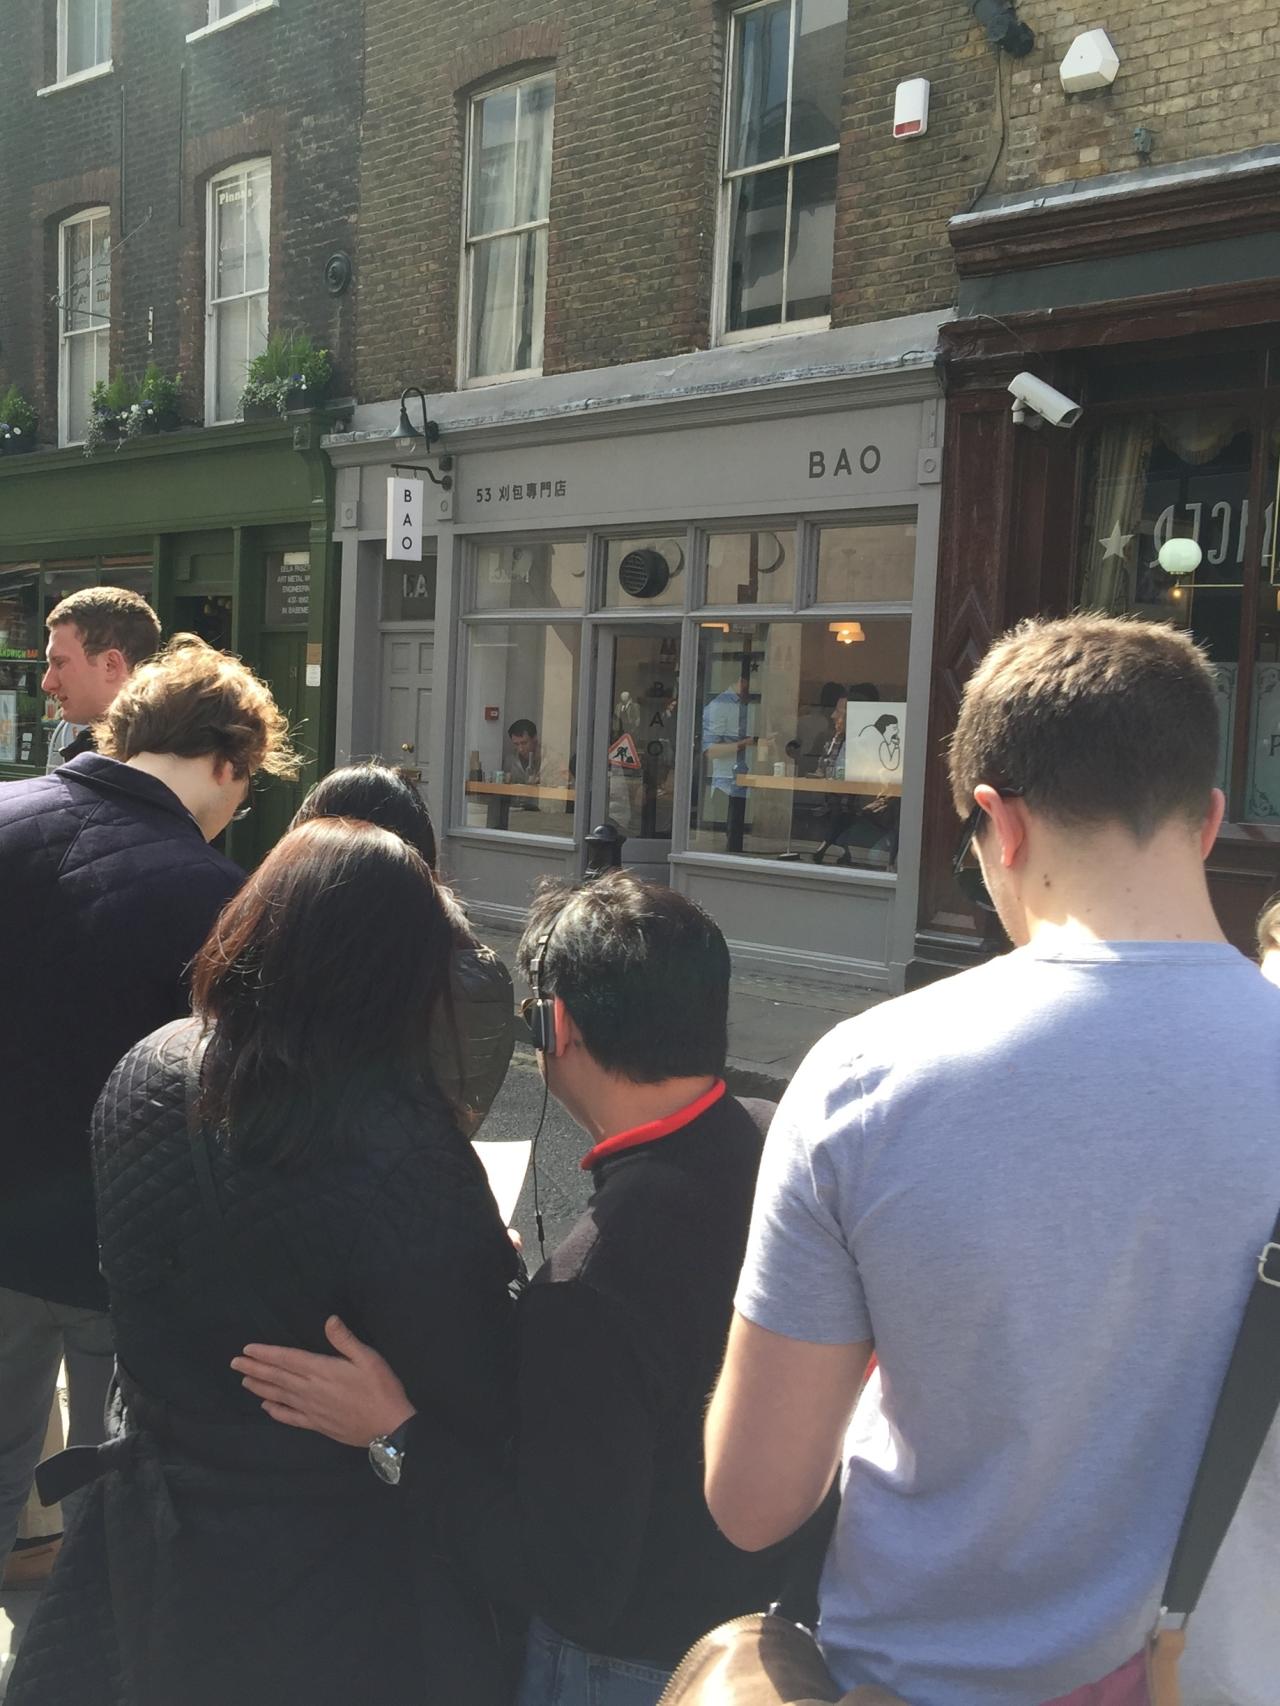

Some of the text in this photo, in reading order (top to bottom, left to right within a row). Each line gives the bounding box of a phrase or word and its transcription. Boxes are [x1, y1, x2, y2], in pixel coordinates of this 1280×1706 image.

[808, 444, 881, 479] BAO
[476, 480, 567, 503] 53 刈包專門店
[401, 489, 413, 550] BAO
[647, 681, 664, 757] BAO
